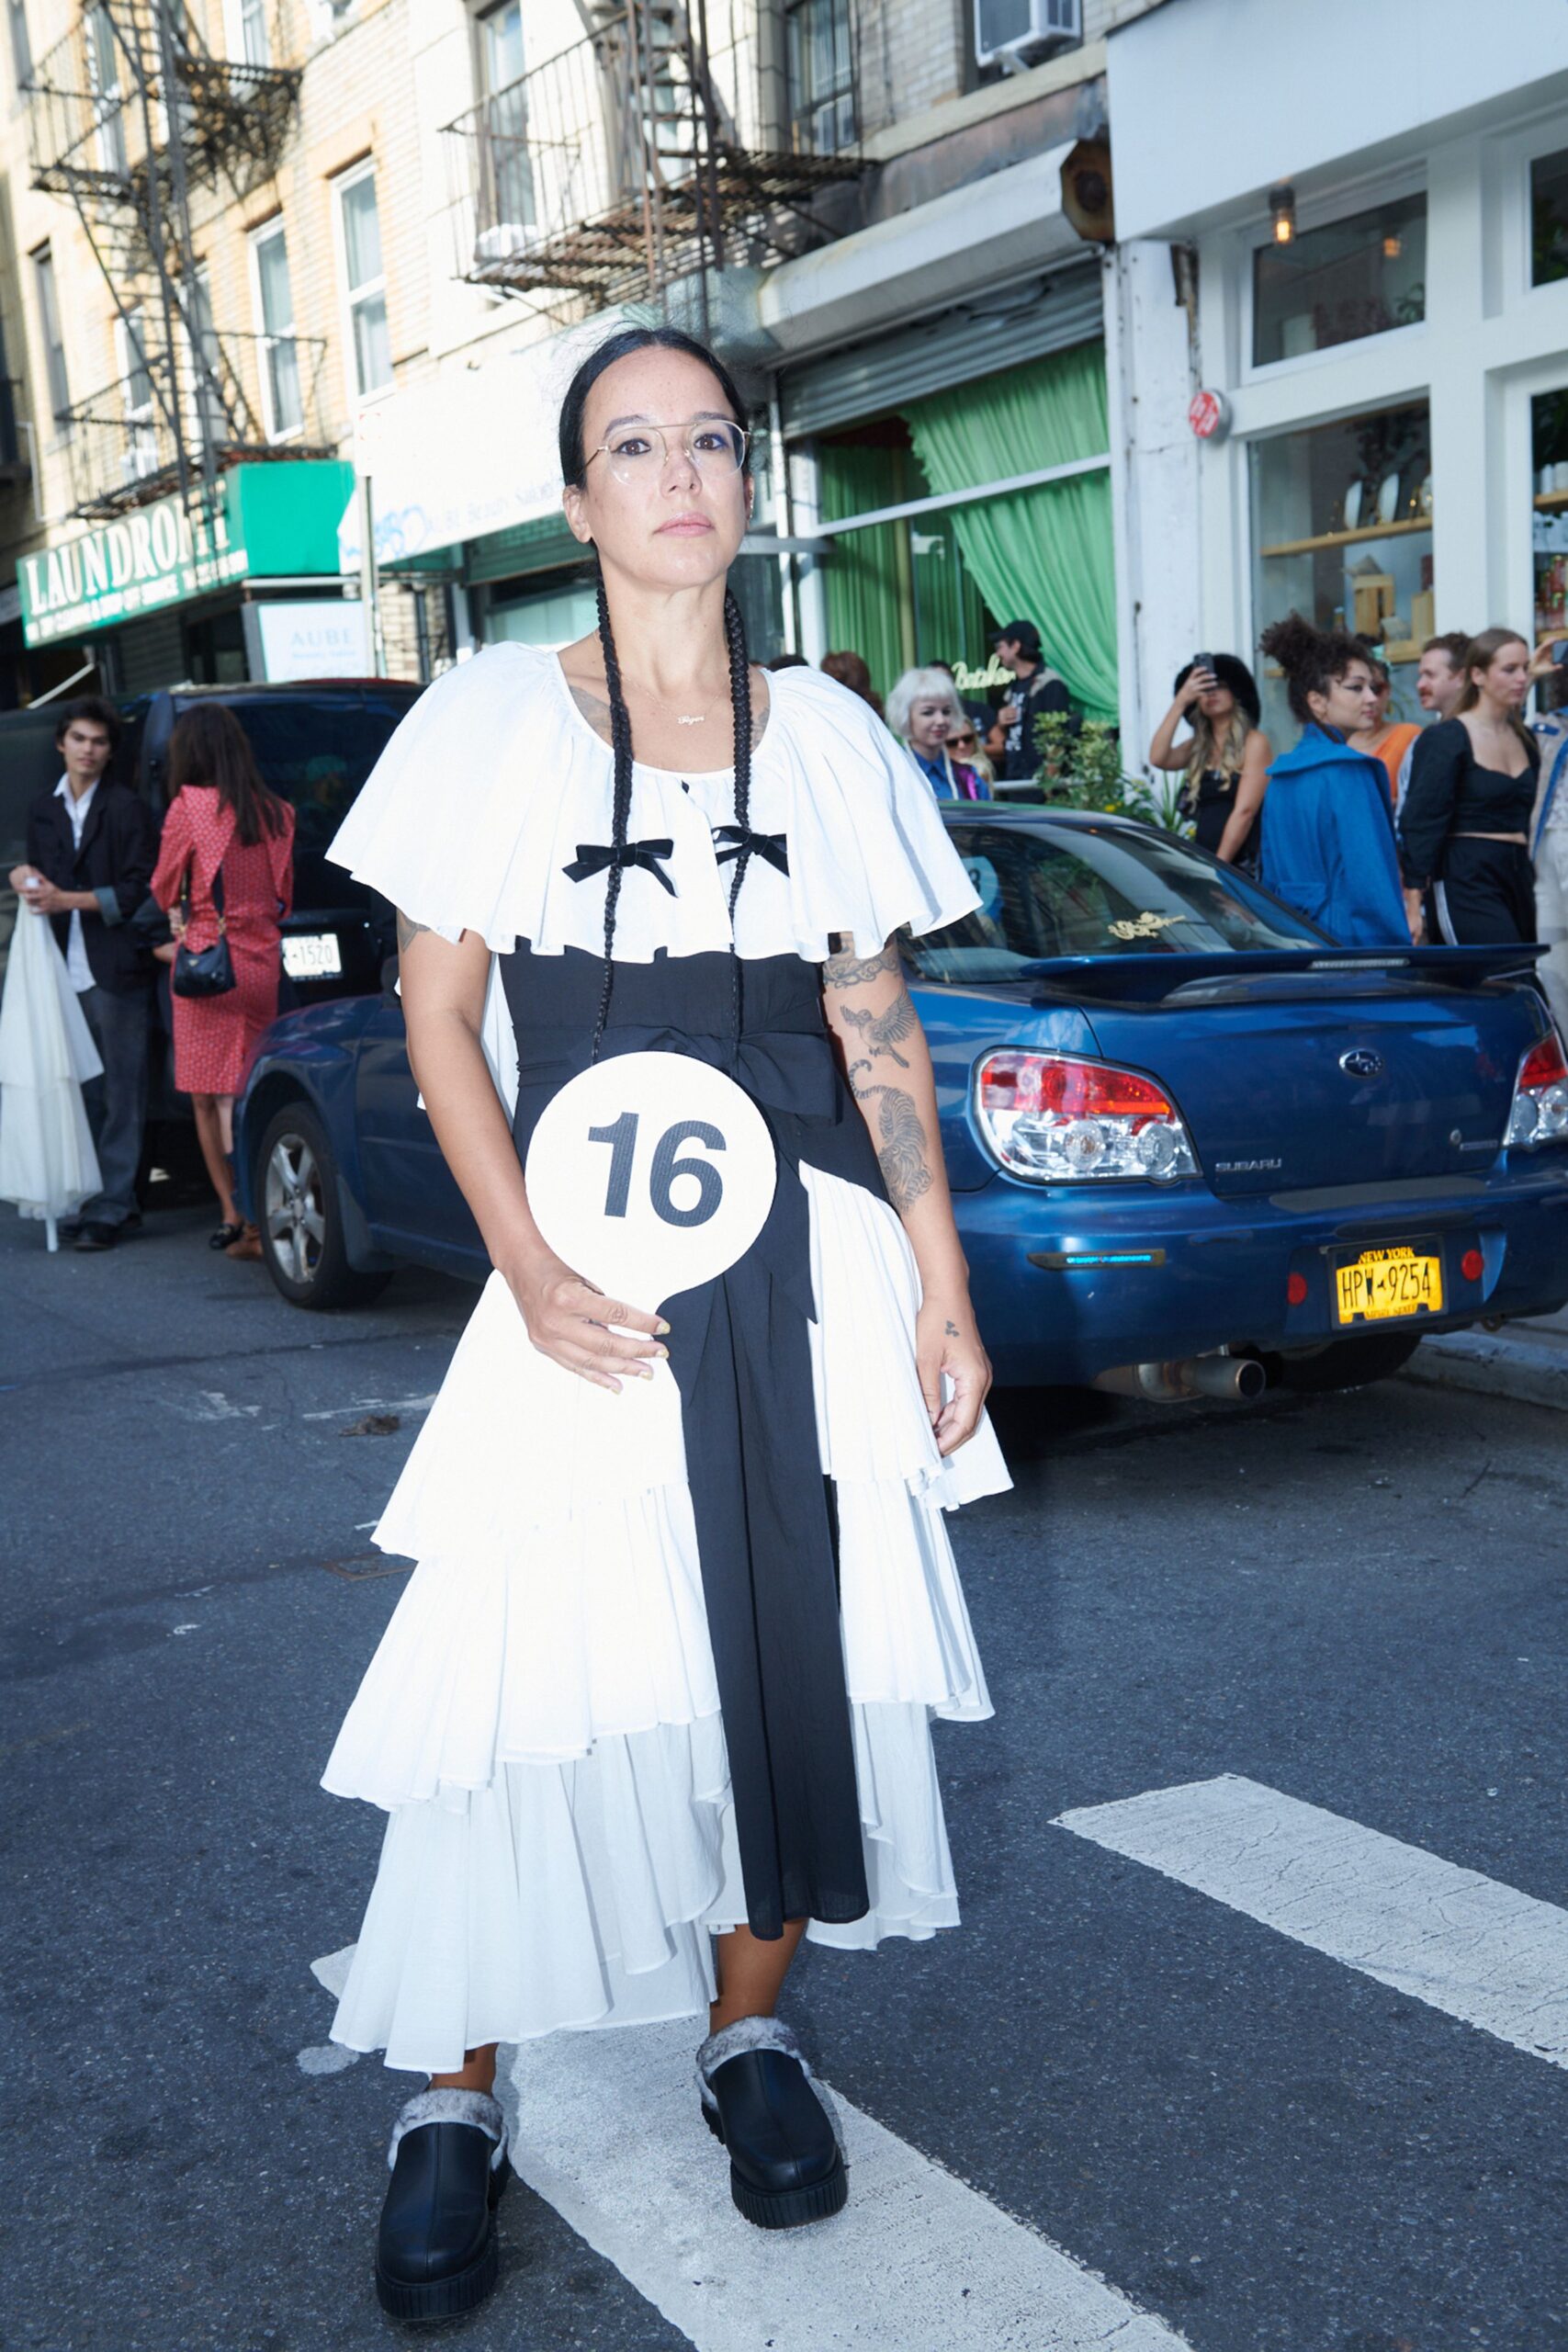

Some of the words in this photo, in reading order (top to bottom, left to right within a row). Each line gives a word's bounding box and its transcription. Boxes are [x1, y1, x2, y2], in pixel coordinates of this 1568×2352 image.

[587, 1111, 728, 1228] 16
[1215, 1158, 1282, 1172] SUBARU
[1358, 1250, 1384, 1265] NEW
[1386, 1246, 1416, 1261] YORK
